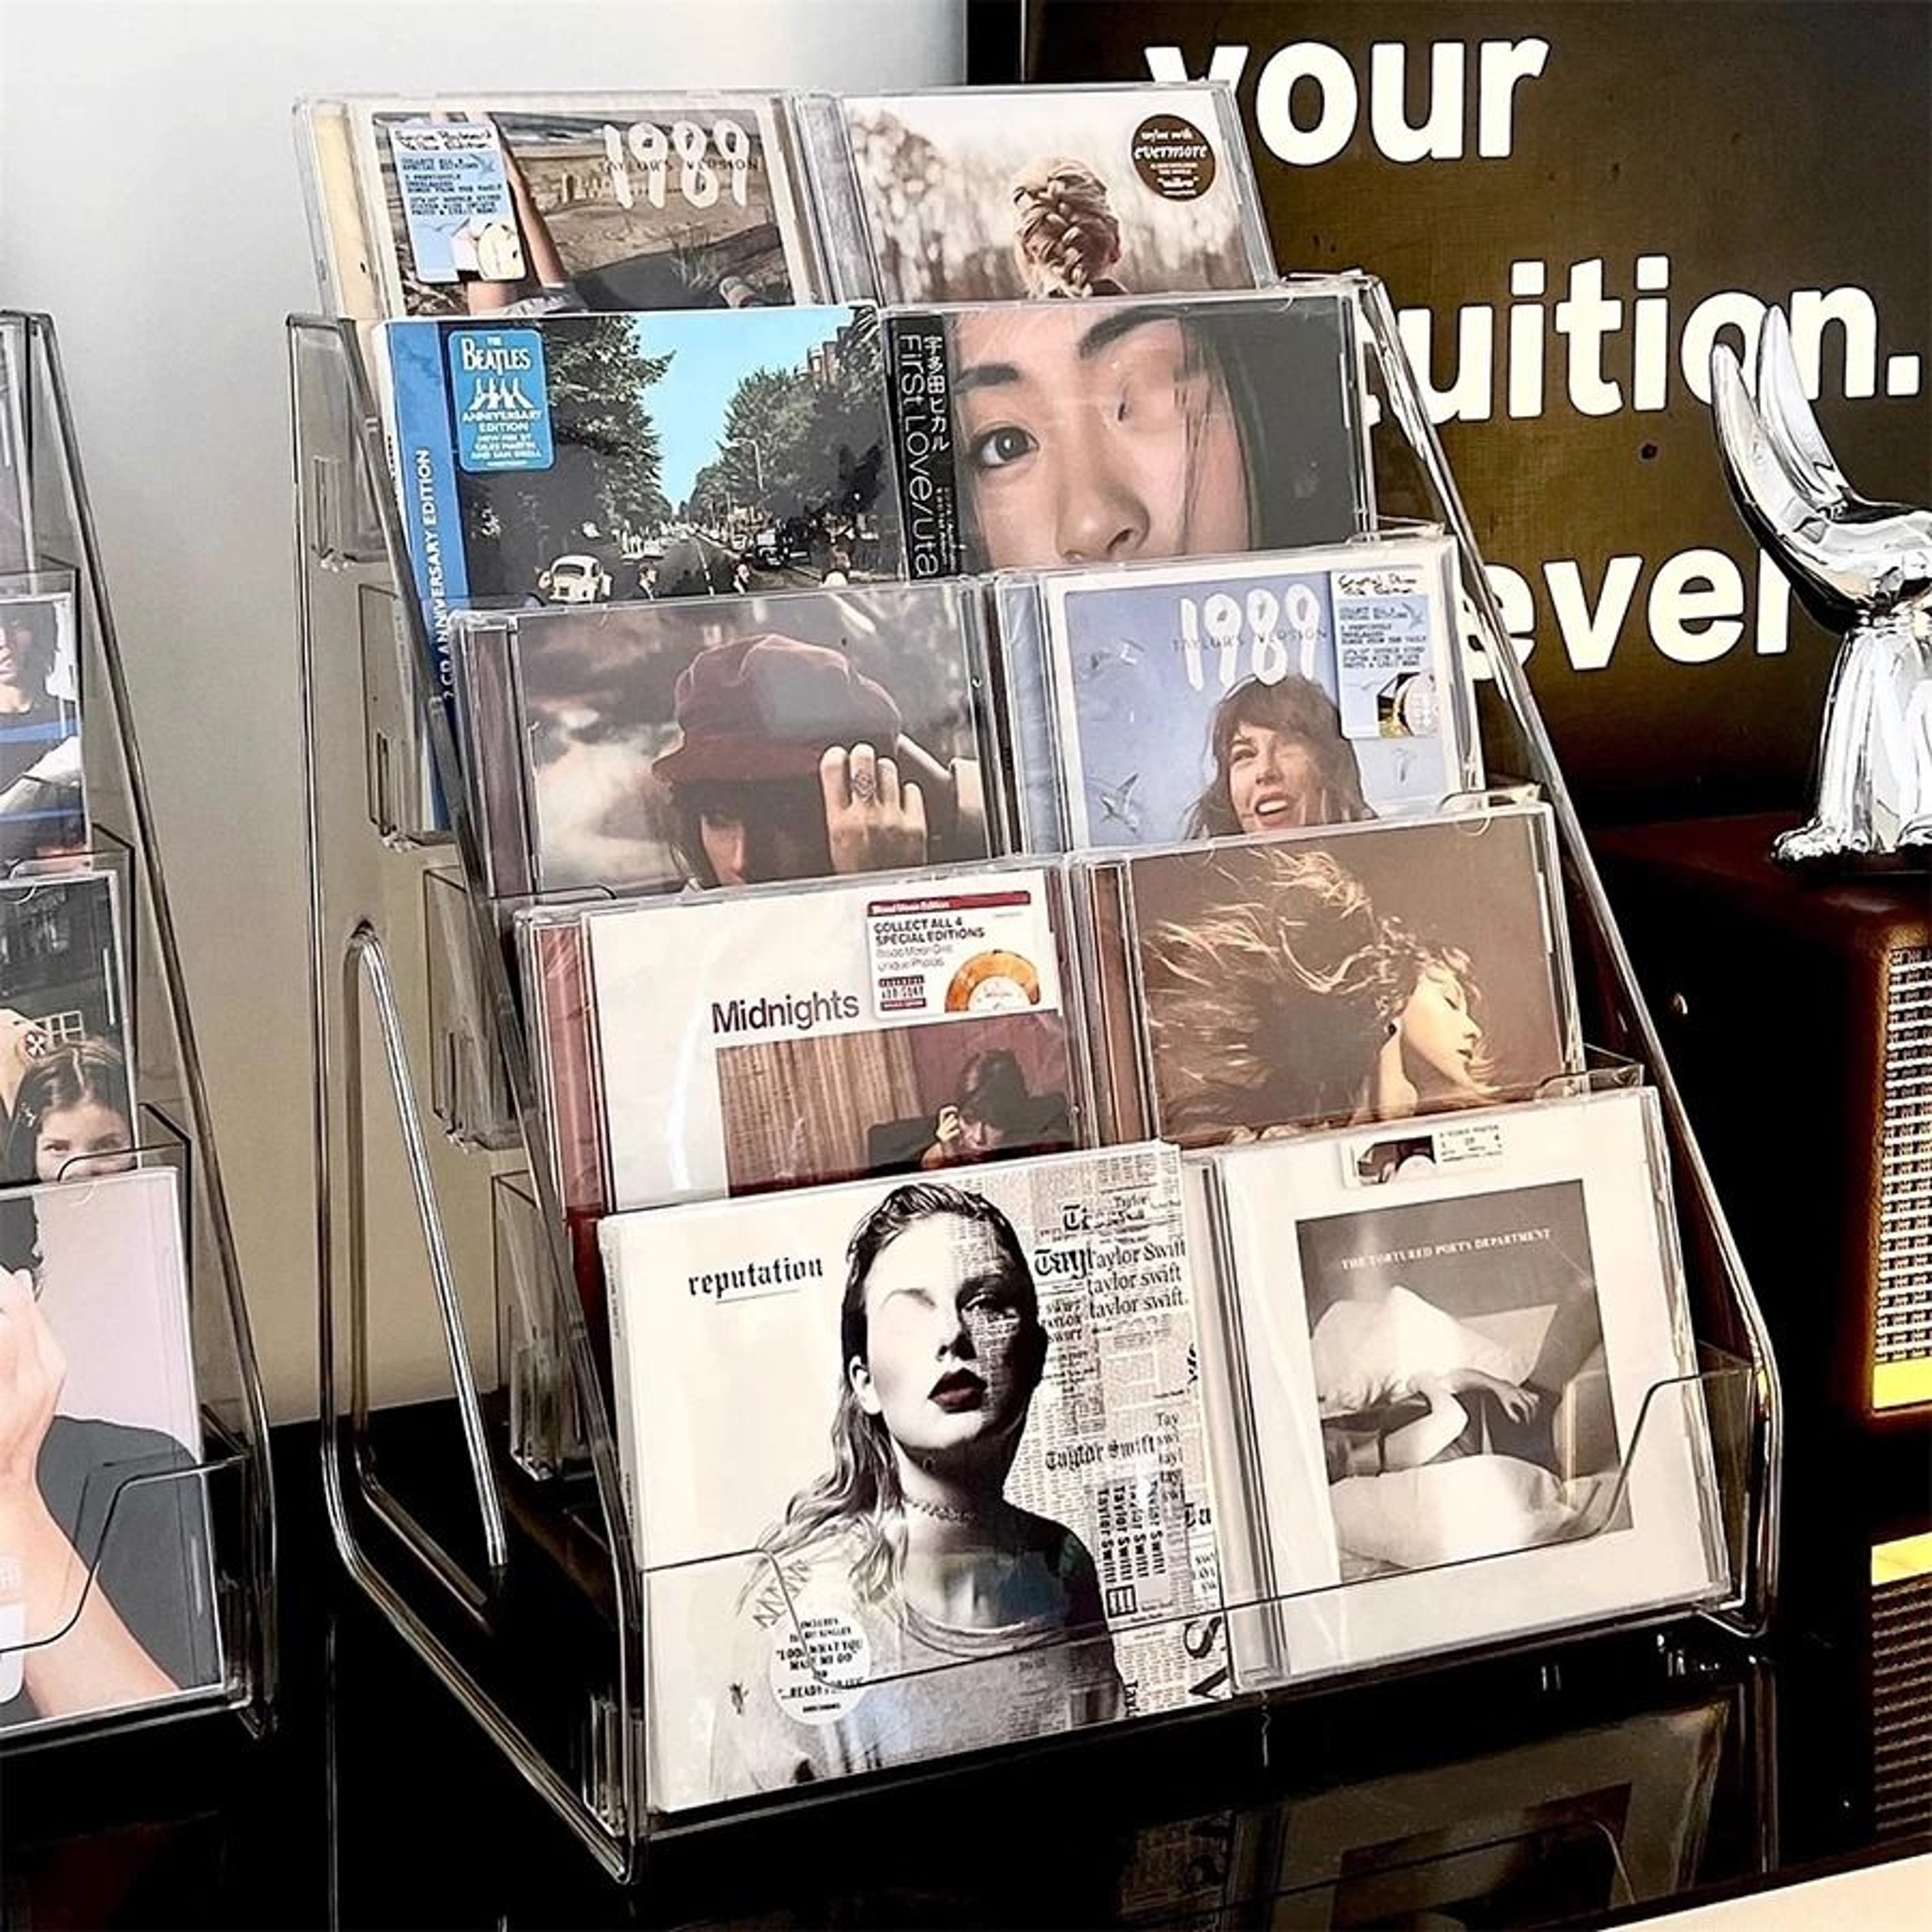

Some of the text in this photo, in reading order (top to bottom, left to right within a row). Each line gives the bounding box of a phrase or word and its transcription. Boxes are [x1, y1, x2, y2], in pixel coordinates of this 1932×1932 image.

[604, 120, 750, 209] 1989
[1134, 145, 1207, 159] evermore
[1359, 257, 1920, 426] uition.
[923, 336, 950, 452] 宇多田ヒカル
[479, 423, 528, 432] EDITION
[416, 449, 437, 525] EDITION
[424, 530, 449, 654] ANNIVERSARY
[1180, 584, 1320, 691] 1989
[873, 919, 928, 934] COLLECT
[930, 918, 952, 928] ALL
[875, 927, 985, 945] SPECIAL EDITIONS
[712, 990, 859, 1033] Midnights
[688, 1257, 823, 1299] reputation
